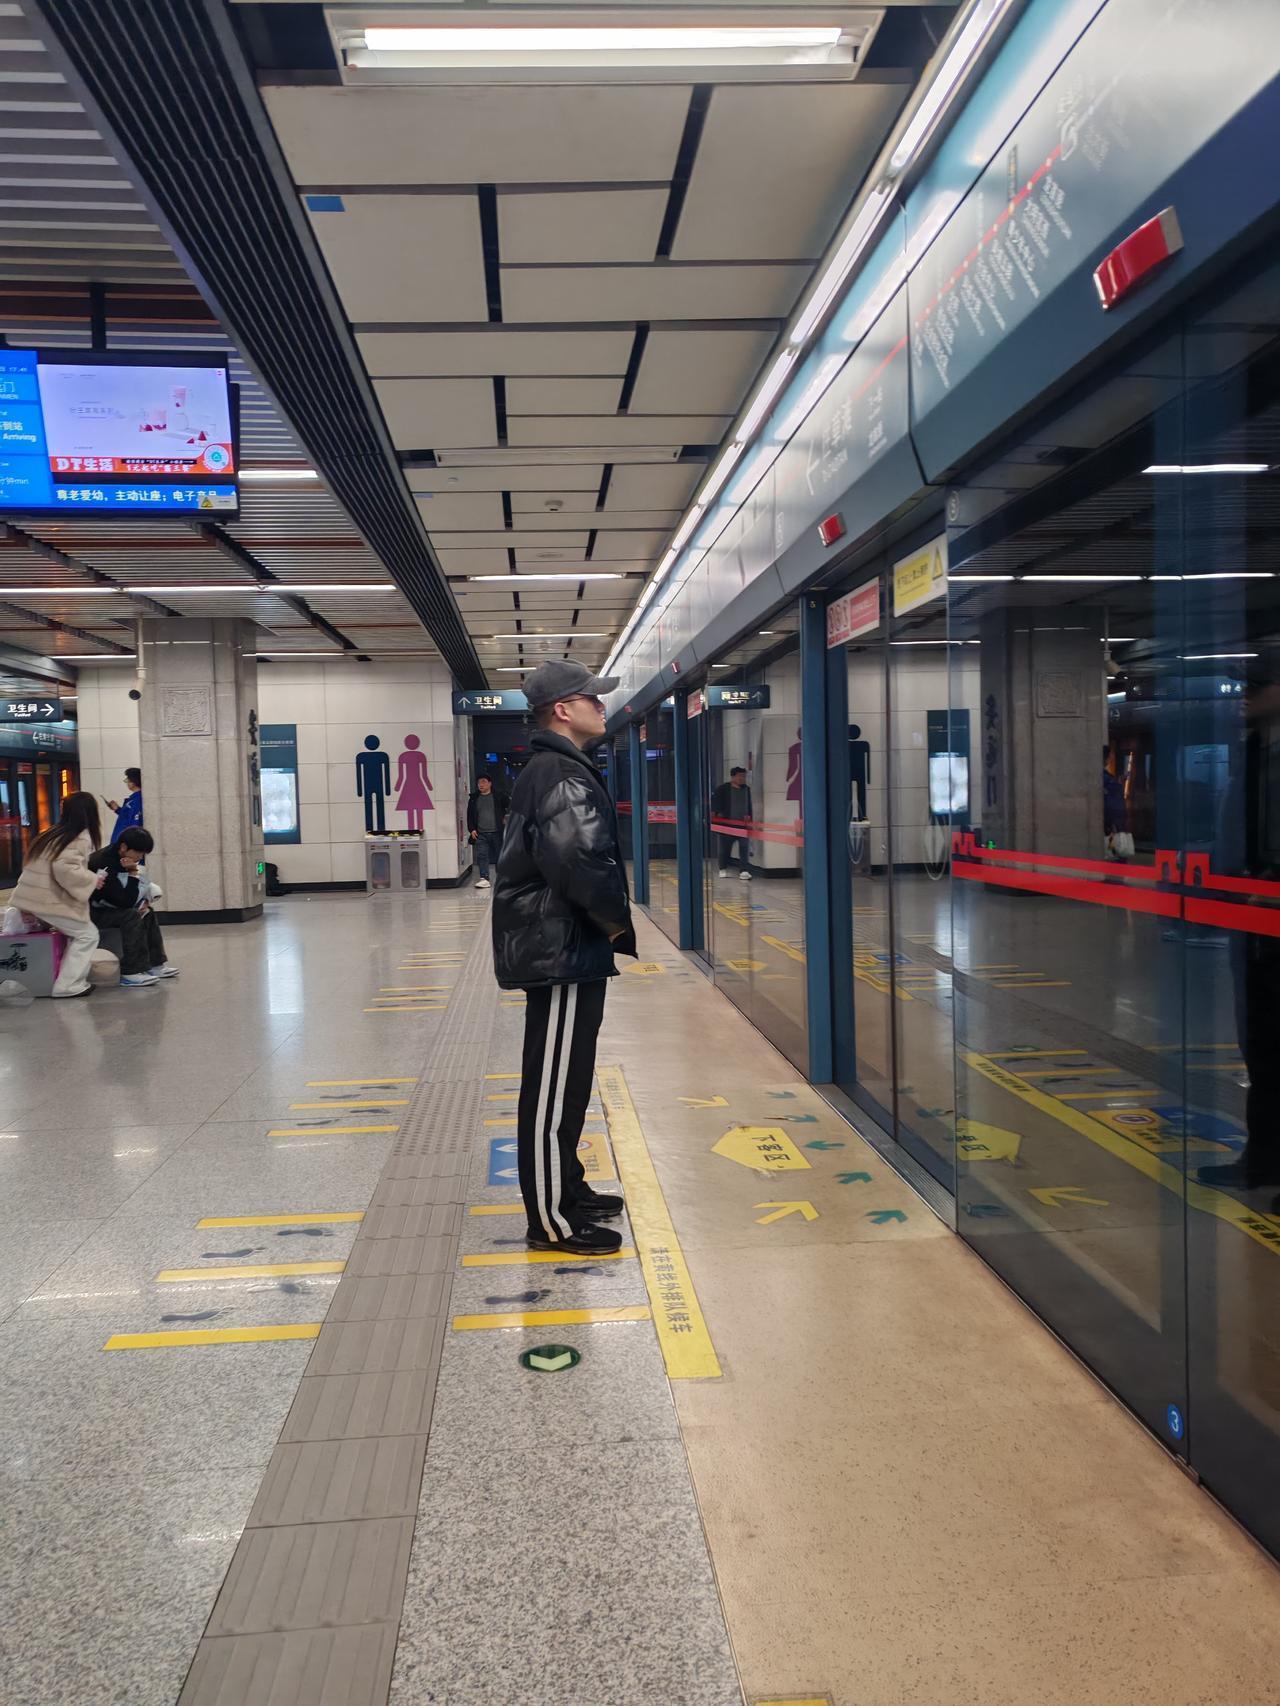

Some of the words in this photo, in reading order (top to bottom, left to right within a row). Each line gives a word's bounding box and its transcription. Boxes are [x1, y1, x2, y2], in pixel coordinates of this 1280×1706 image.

[56, 457, 113, 472] DT生活
[474, 695, 502, 705] 卫生间
[7, 703, 38, 713] 卫生间
[751, 1134, 792, 1162] 下客区
